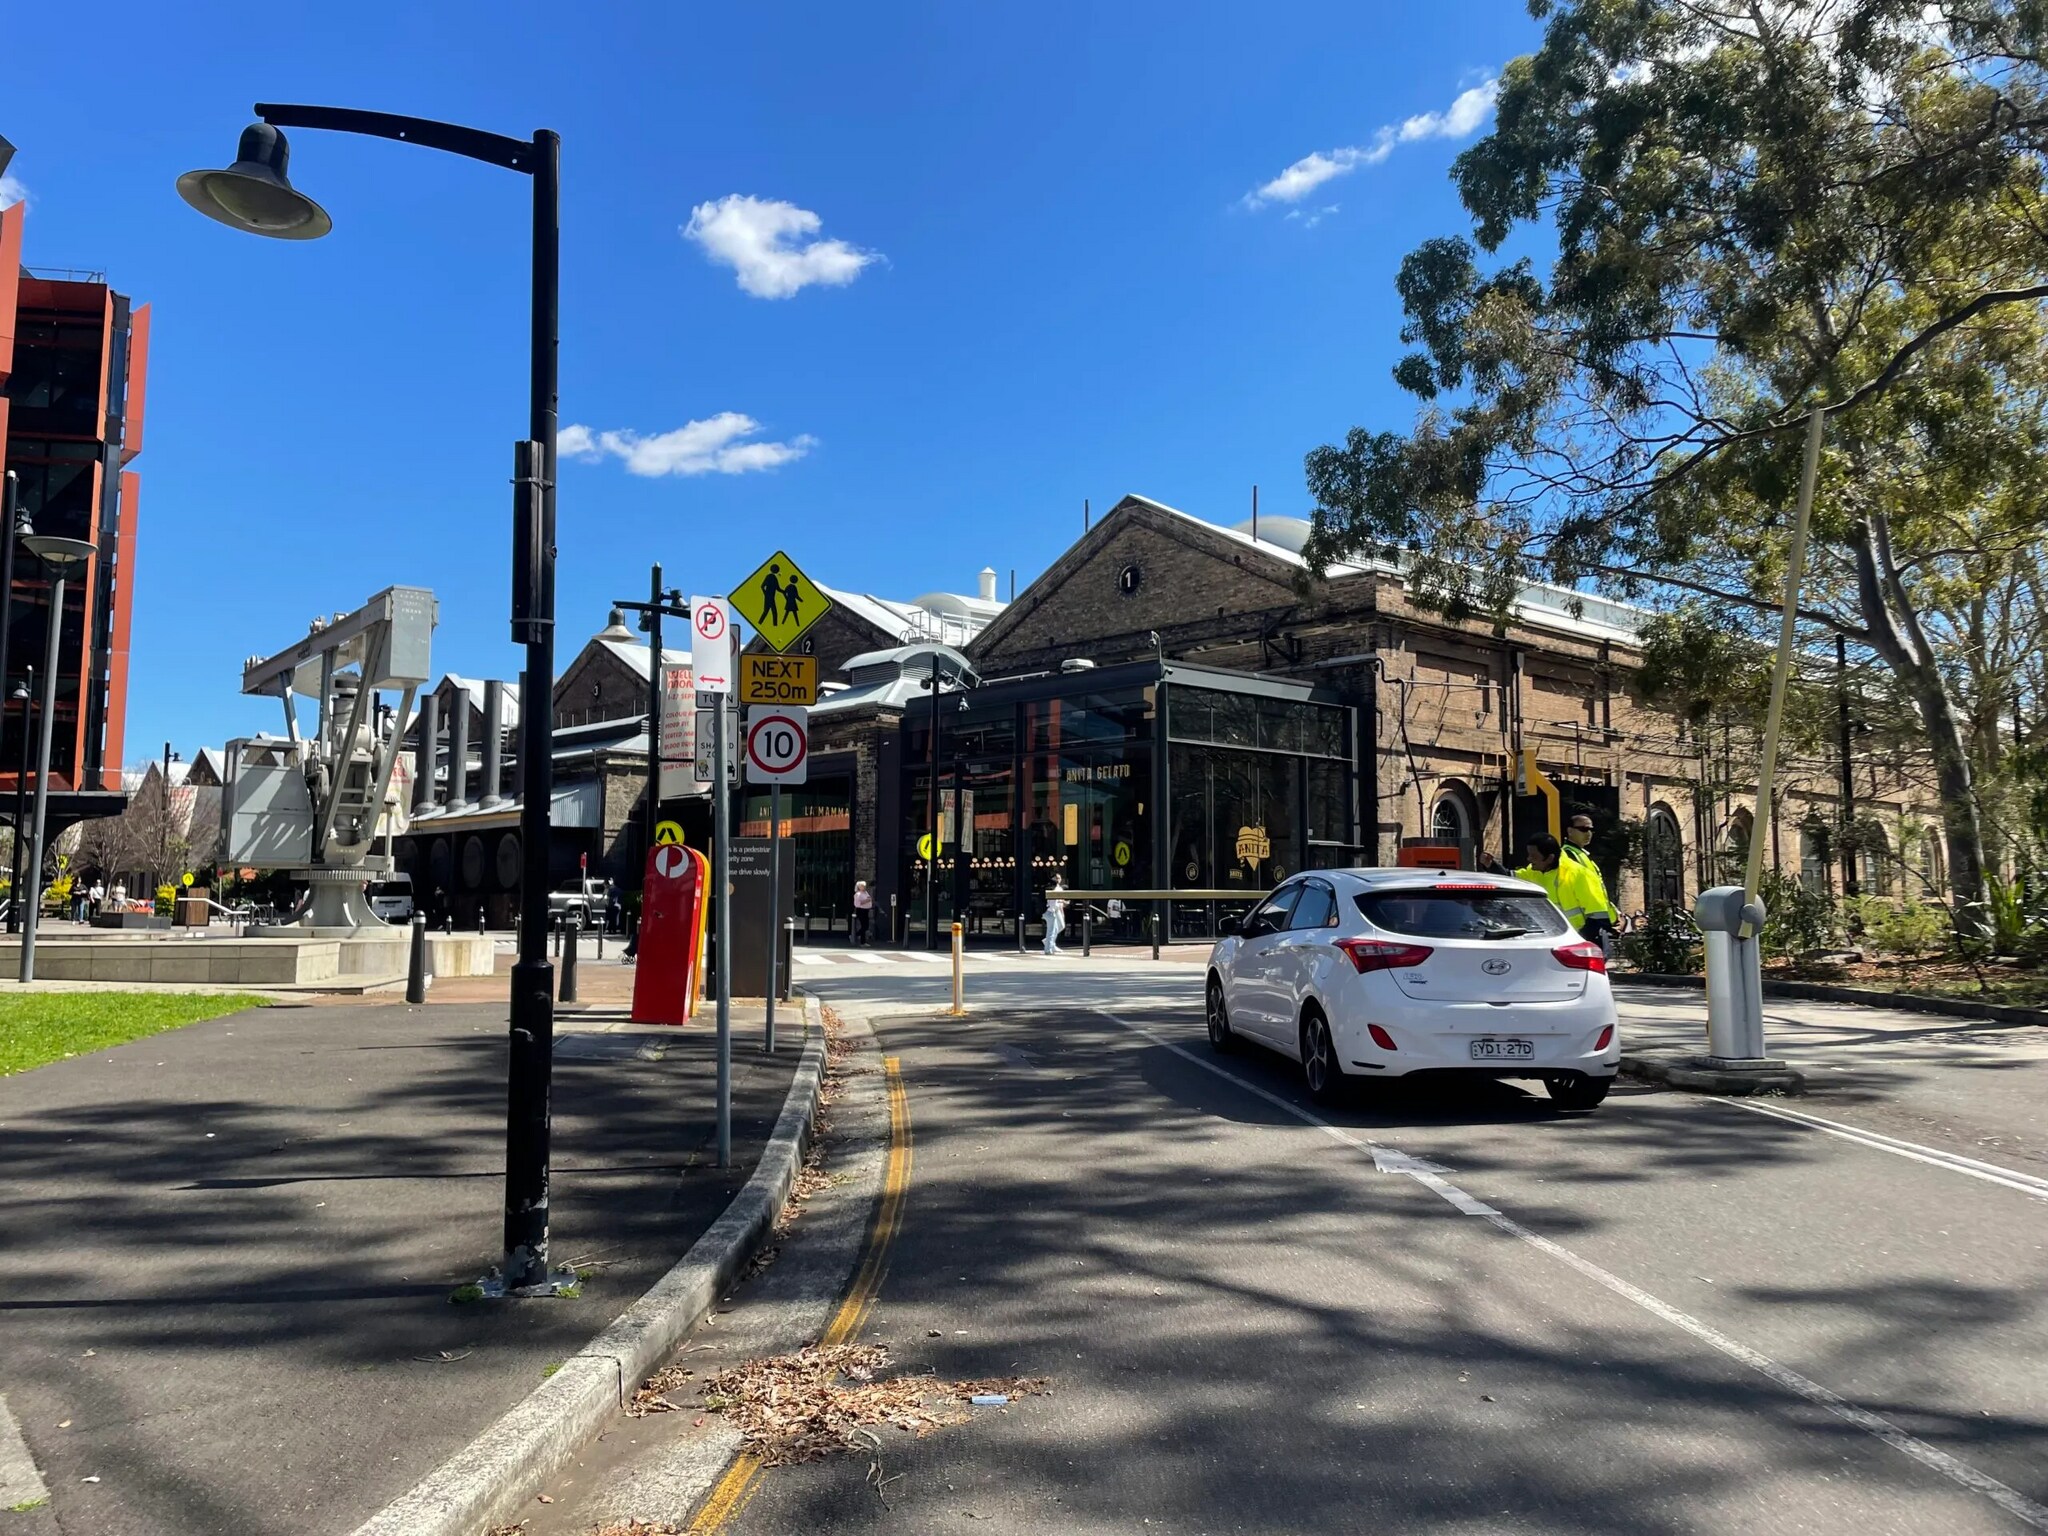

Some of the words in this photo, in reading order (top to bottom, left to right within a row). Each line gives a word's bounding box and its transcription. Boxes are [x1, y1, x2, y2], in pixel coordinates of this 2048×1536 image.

[1125, 572, 1131, 588] 1
[804, 641, 811, 653] 2
[752, 661, 805, 678] NEXT
[751, 682, 807, 699] 250m
[702, 694, 734, 703] TUN
[764, 731, 794, 758] 10
[1066, 767, 1092, 782] ANITA
[1097, 764, 1131, 780] GELATO
[804, 805, 815, 816] LA
[818, 805, 849, 818] MAMMA
[1238, 842, 1268, 856] ANITA
[752, 868, 771, 877] slowly
